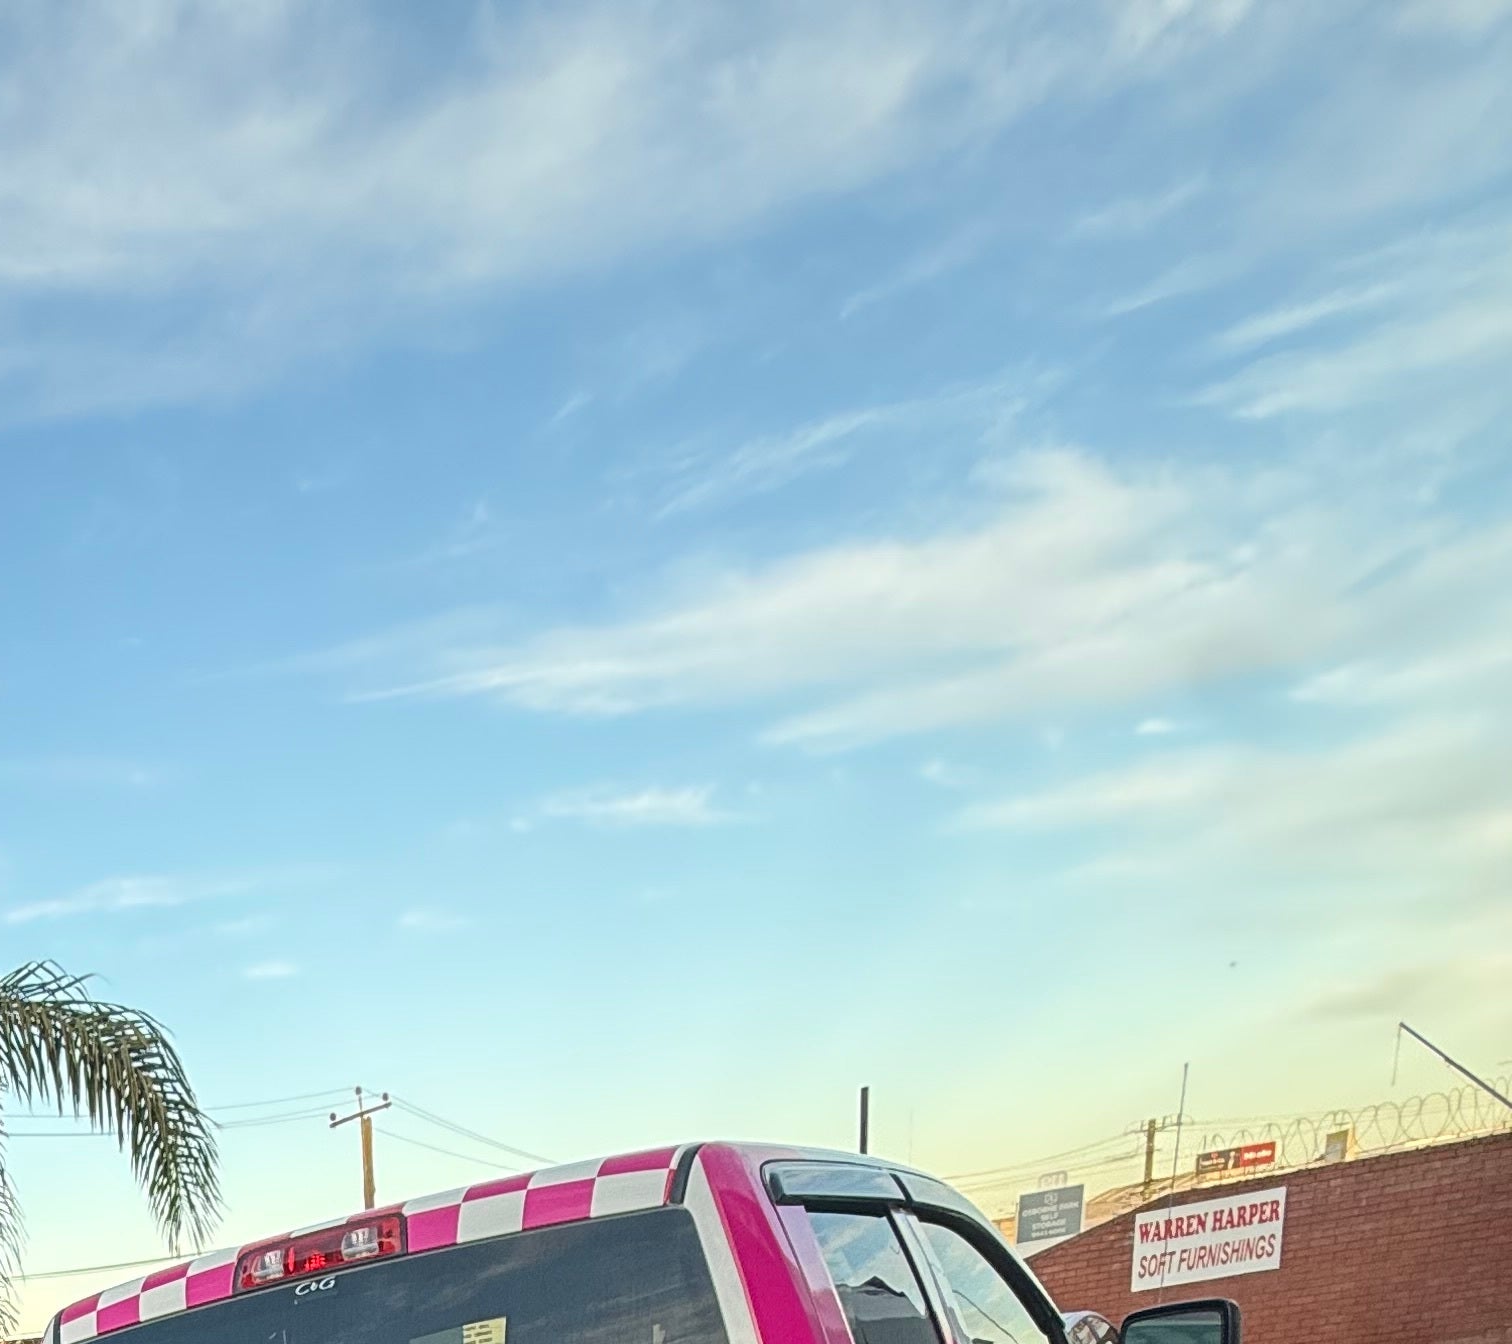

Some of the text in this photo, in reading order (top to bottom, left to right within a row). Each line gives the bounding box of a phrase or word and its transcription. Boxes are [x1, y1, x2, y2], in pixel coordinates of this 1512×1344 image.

[1139, 1200, 1280, 1243] WARREN HARPER
[1138, 1234, 1276, 1279] SOFT FURNISHINGS
